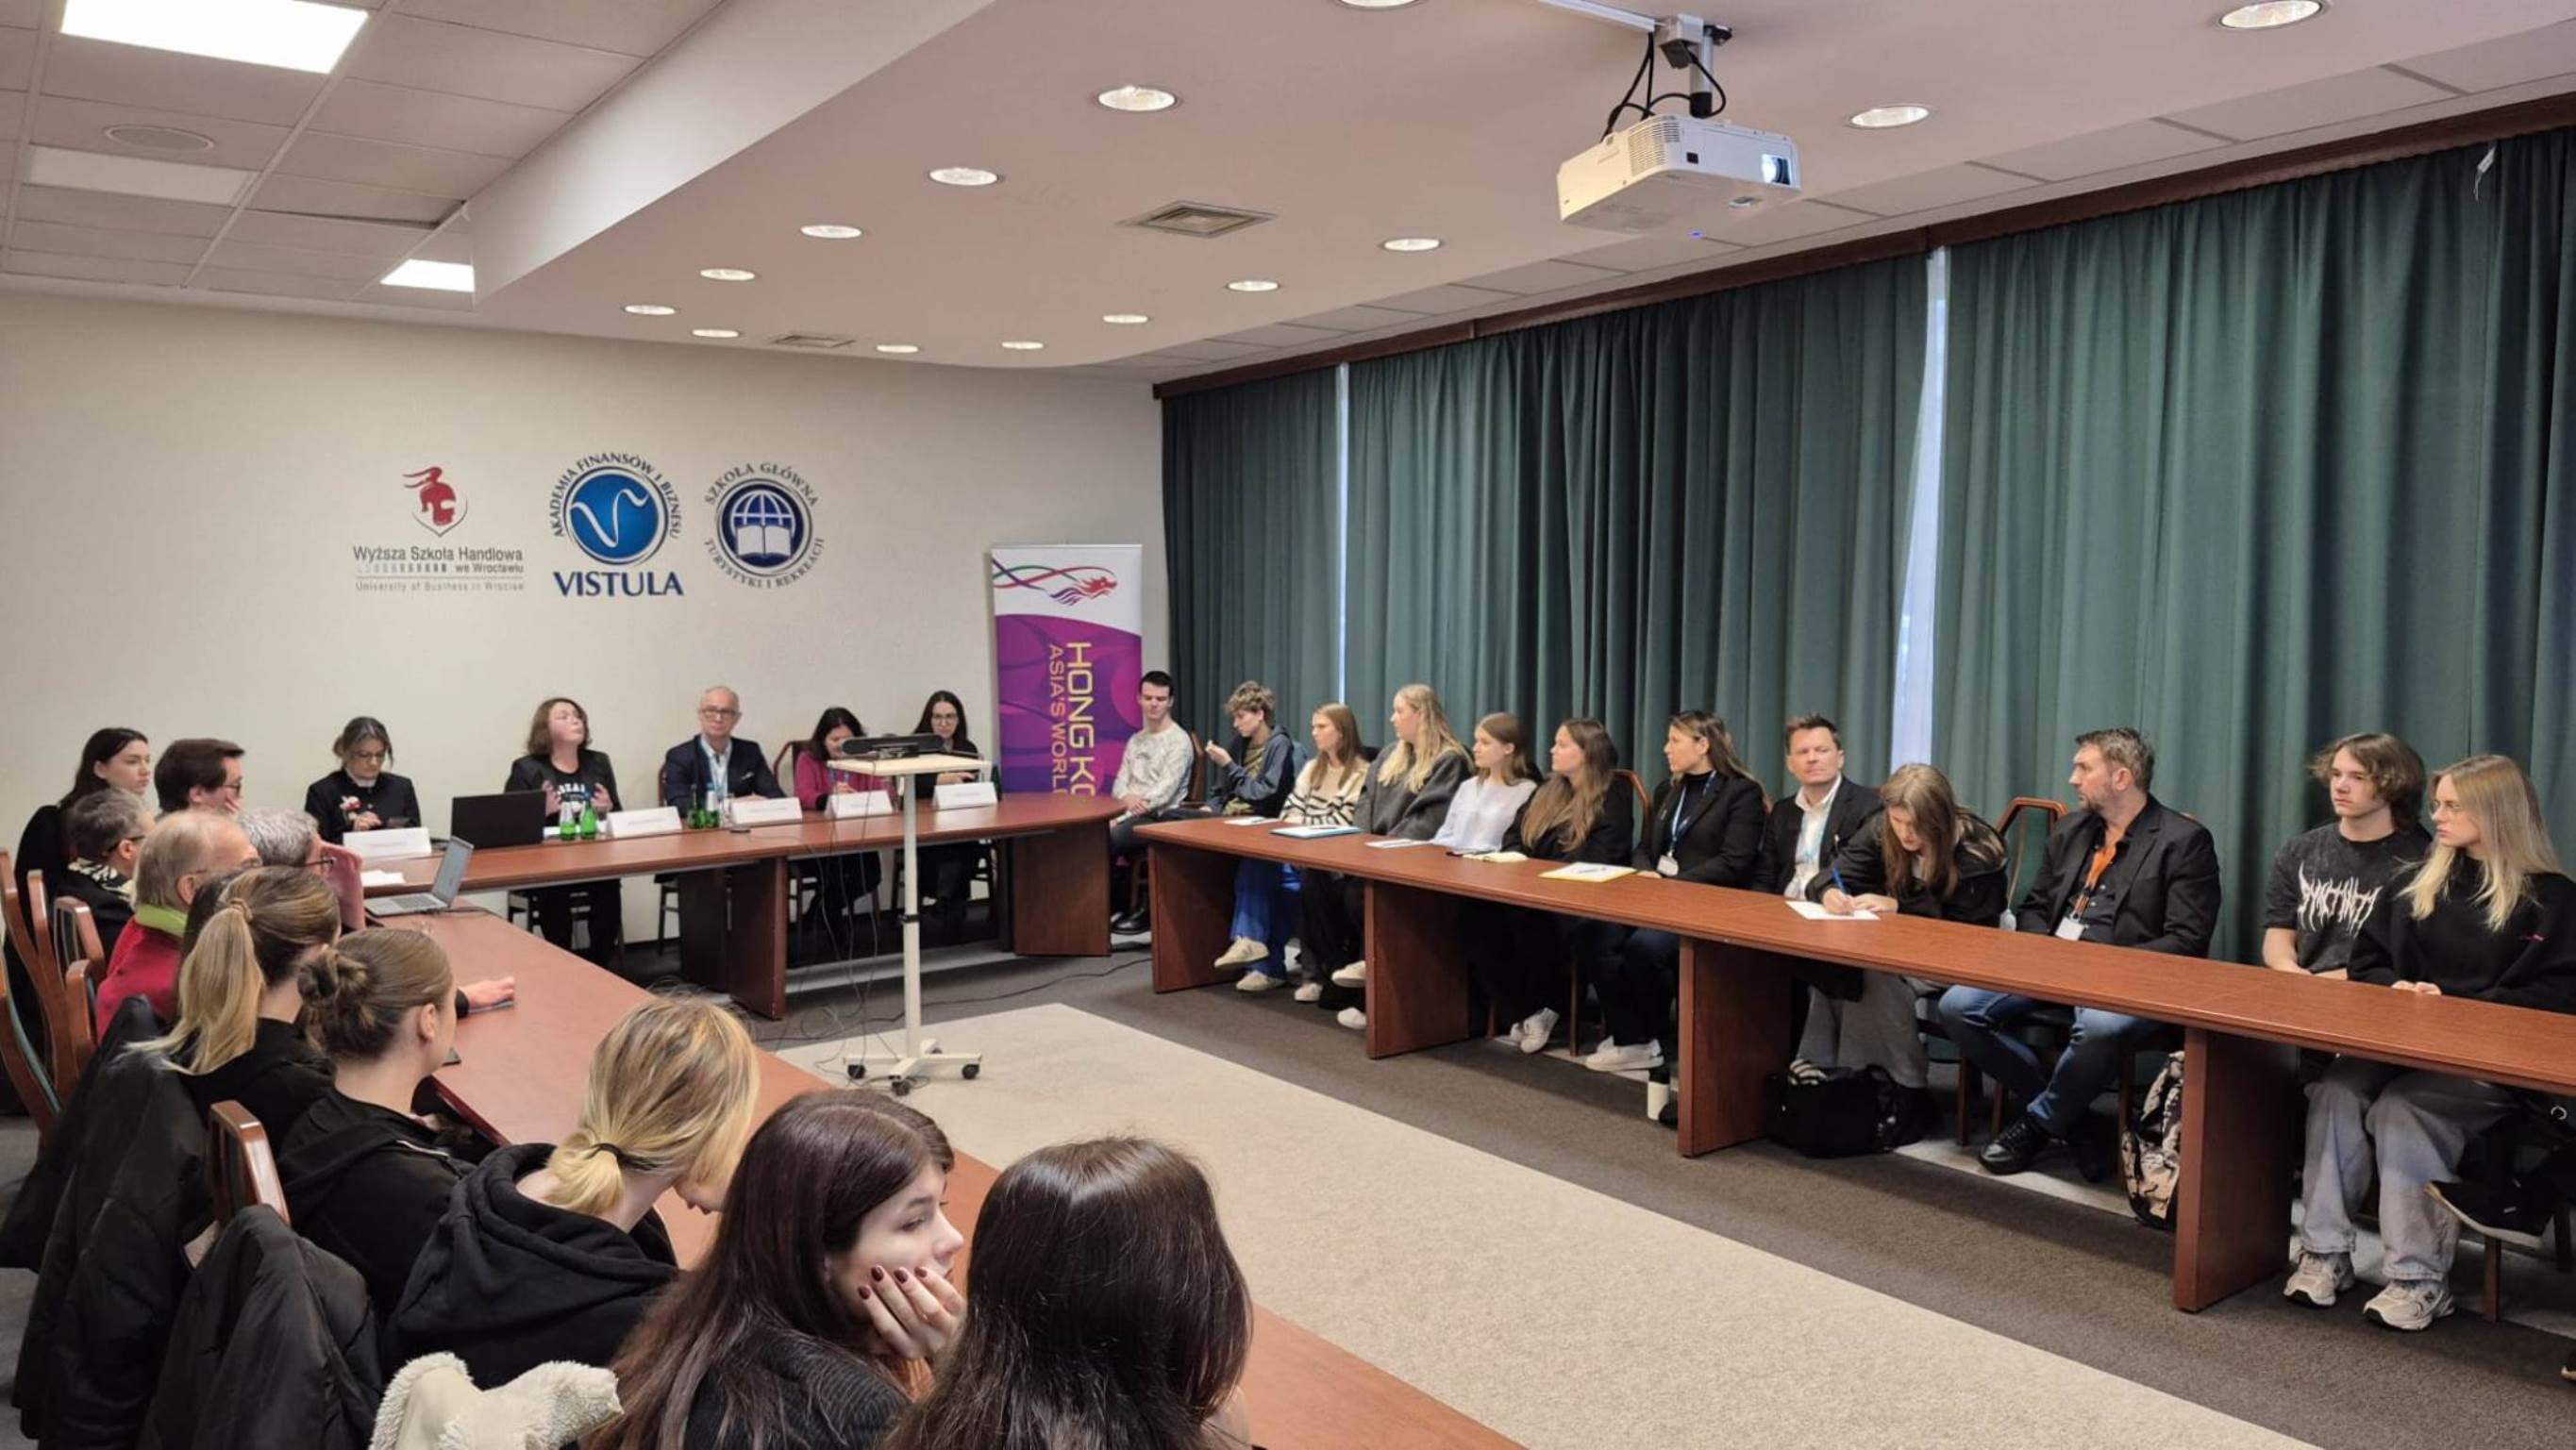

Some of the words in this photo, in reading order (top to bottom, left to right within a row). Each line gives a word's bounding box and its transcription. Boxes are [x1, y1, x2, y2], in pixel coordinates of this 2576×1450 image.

[549, 469, 577, 537] AKADEMIA
[577, 452, 655, 475] FINANSÓW
[661, 481, 682, 539] BIZNESU
[353, 545, 406, 563] Wyższa
[459, 546, 524, 561] Handlowa
[455, 564, 470, 573] we
[356, 581, 406, 592] University
[410, 581, 421, 591] of
[425, 581, 468, 592] Business
[553, 571, 684, 597] VISTULA
[1048, 644, 1065, 717] ASIA'S
[1066, 642, 1095, 748] HONG
[1051, 723, 1068, 793] WORL
